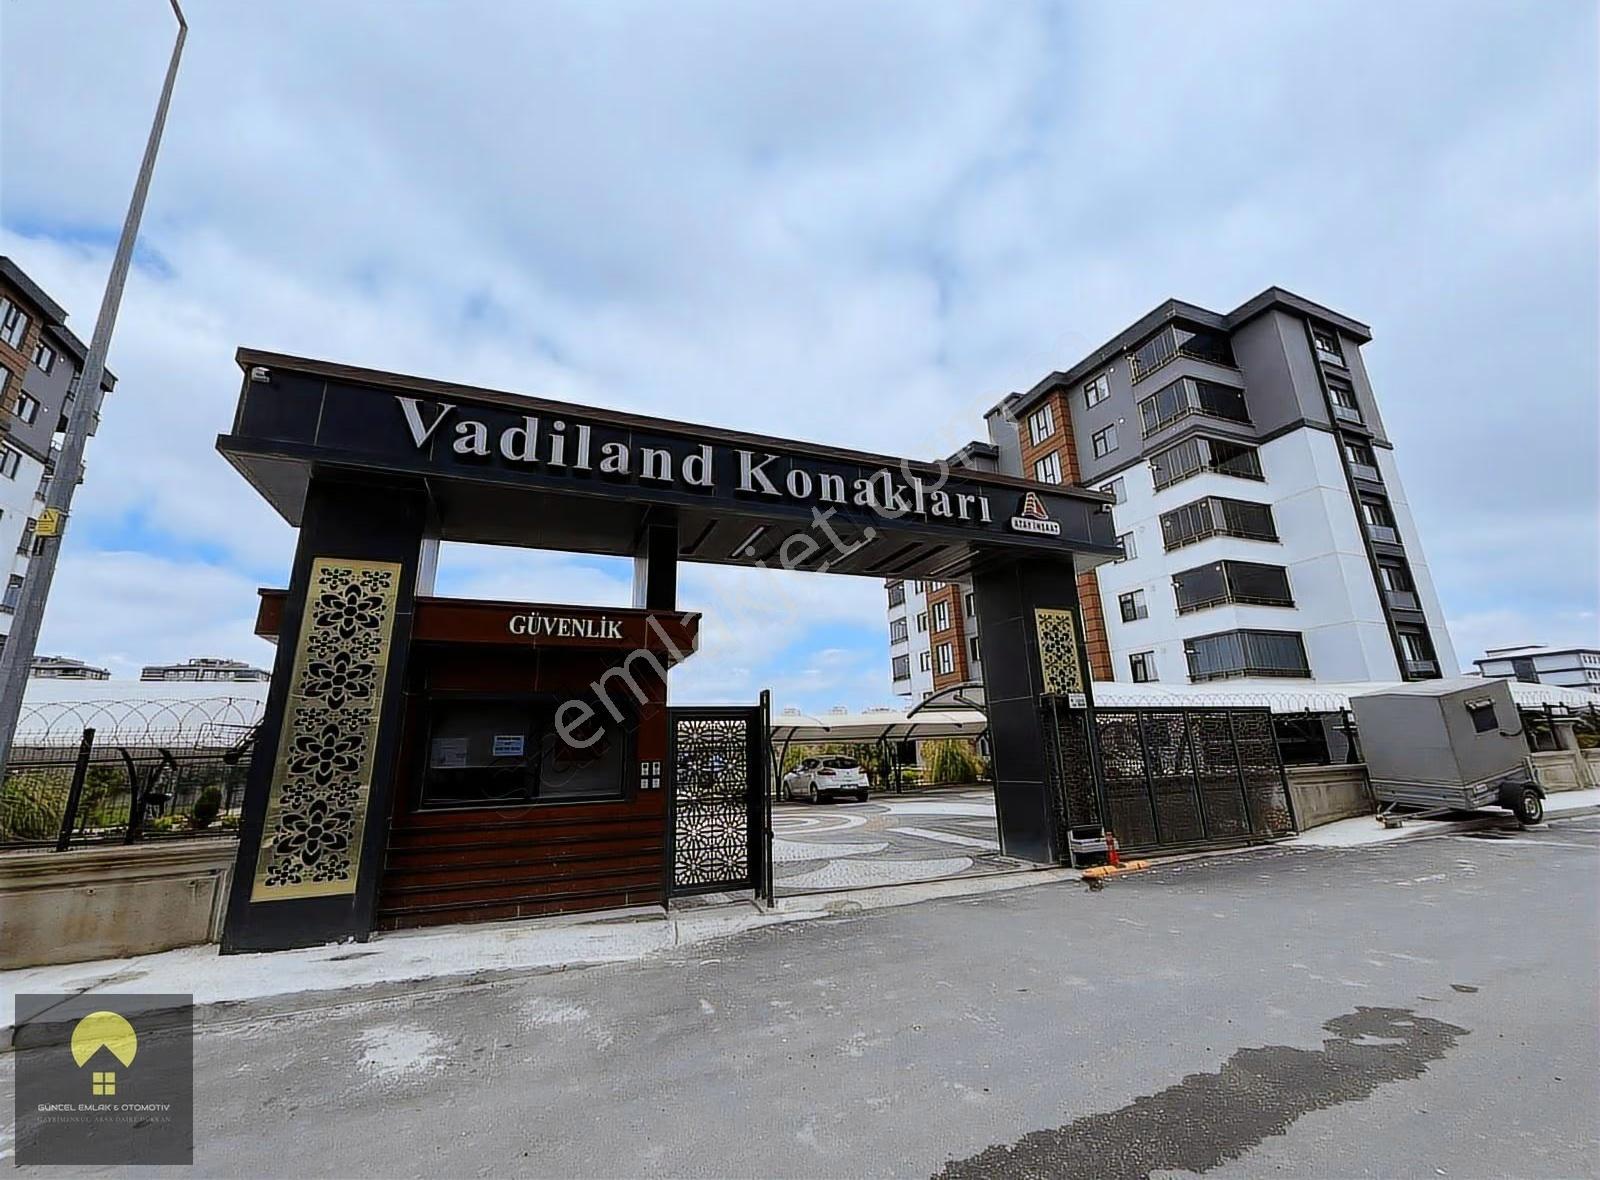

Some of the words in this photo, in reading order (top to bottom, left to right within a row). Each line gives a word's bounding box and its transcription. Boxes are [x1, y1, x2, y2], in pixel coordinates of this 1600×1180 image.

[394, 396, 715, 487] Vadiland
[732, 449, 993, 523] Konakları
[509, 612, 623, 639] GÜVENLİK
